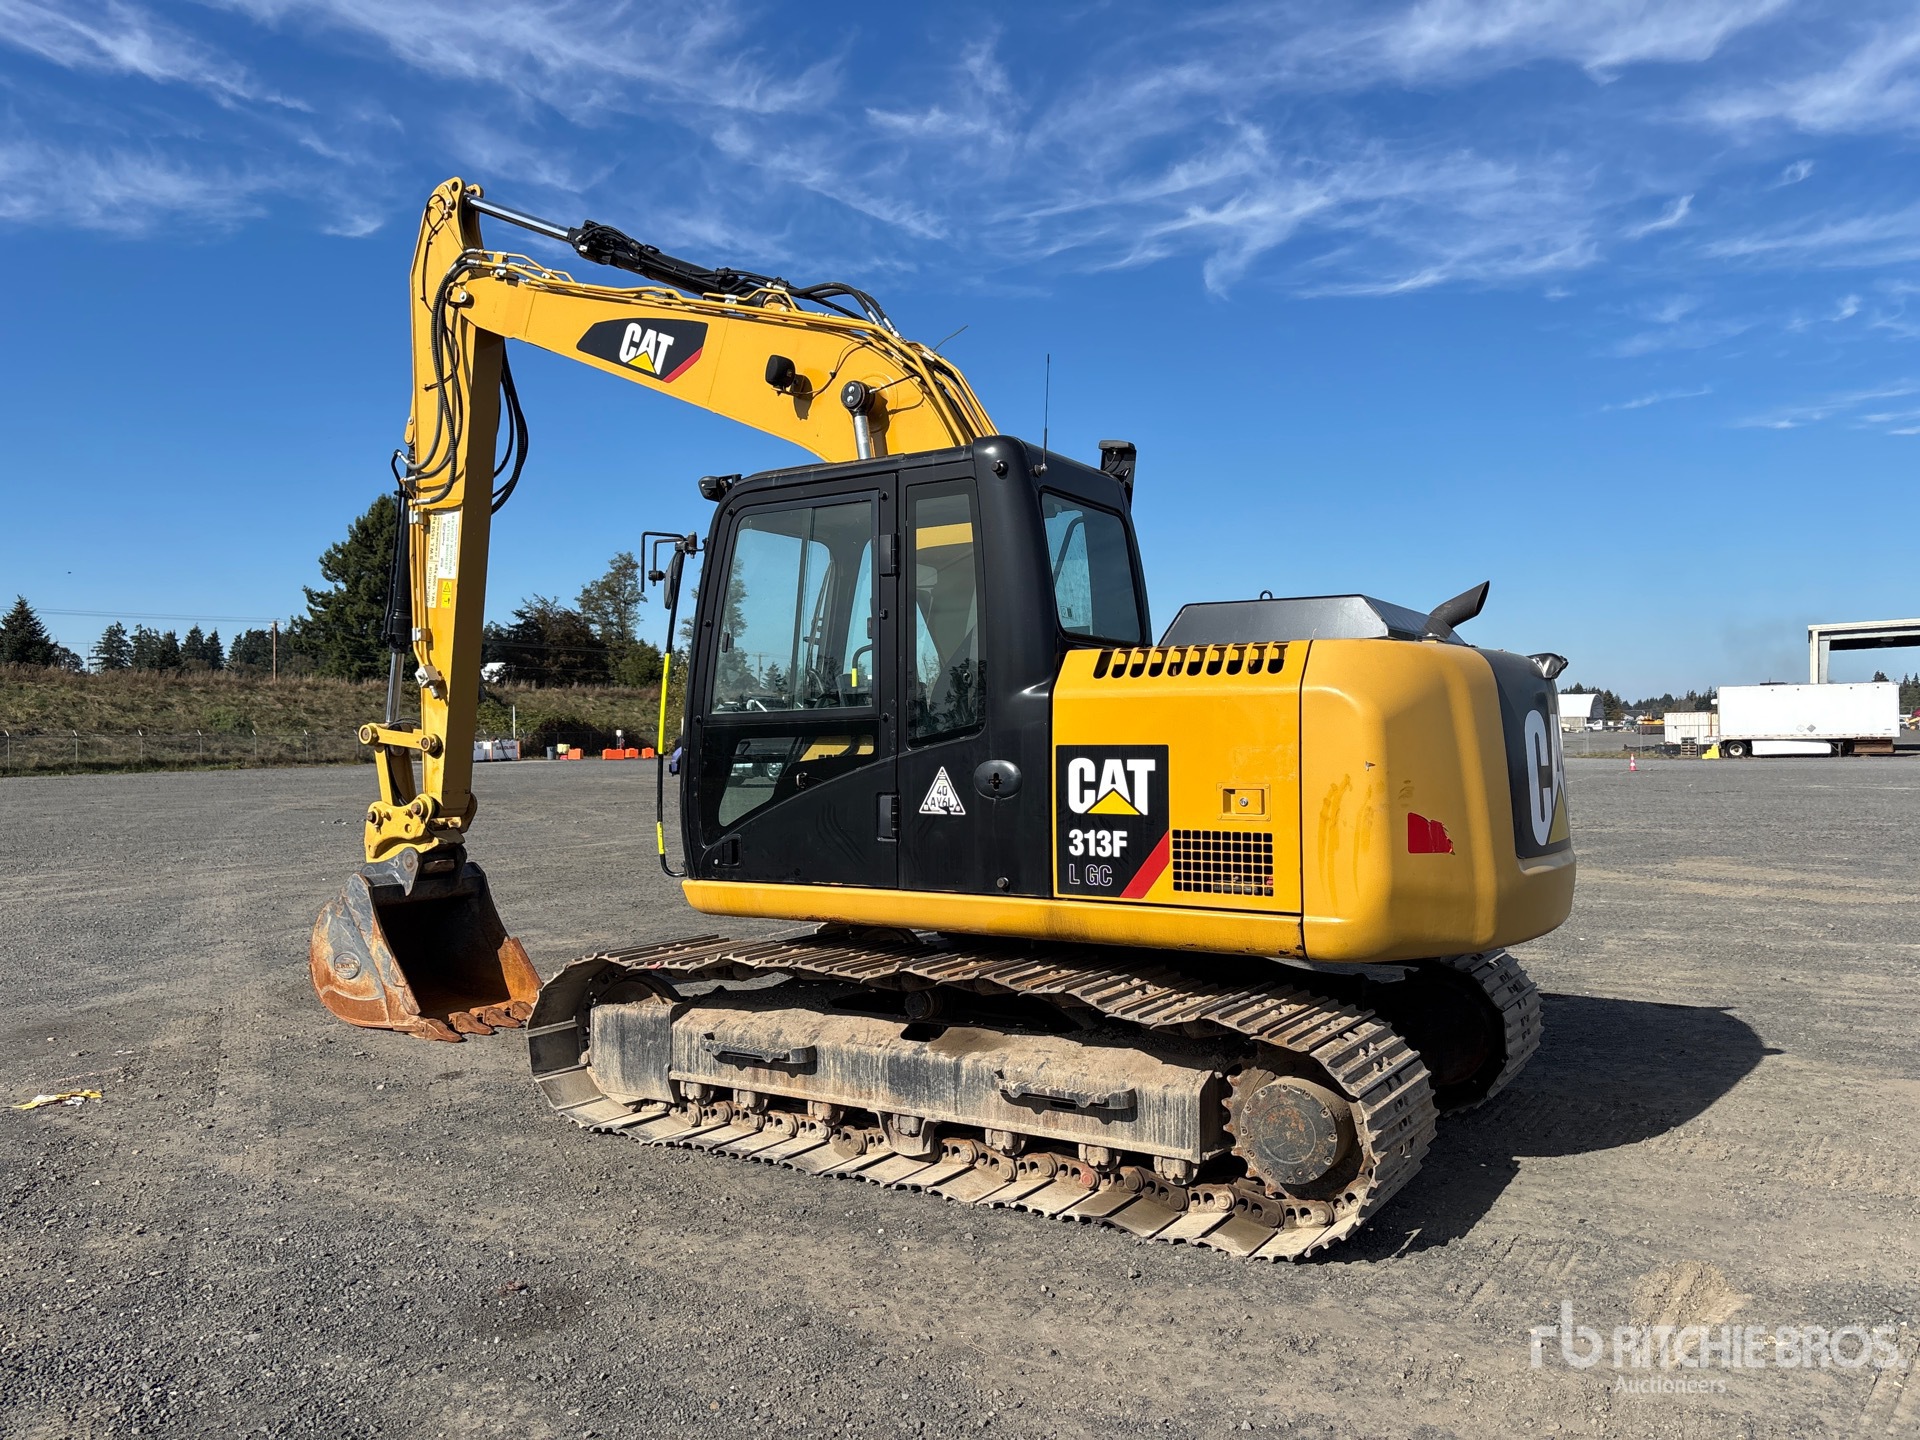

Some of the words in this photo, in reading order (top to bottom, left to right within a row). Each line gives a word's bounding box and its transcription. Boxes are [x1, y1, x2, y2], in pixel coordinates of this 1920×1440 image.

[618, 322, 675, 375] CAT
[1068, 758, 1155, 815] CAT
[1069, 829, 1128, 857] 313F
[1069, 864, 1080, 885] L
[1086, 864, 1112, 886] GC
